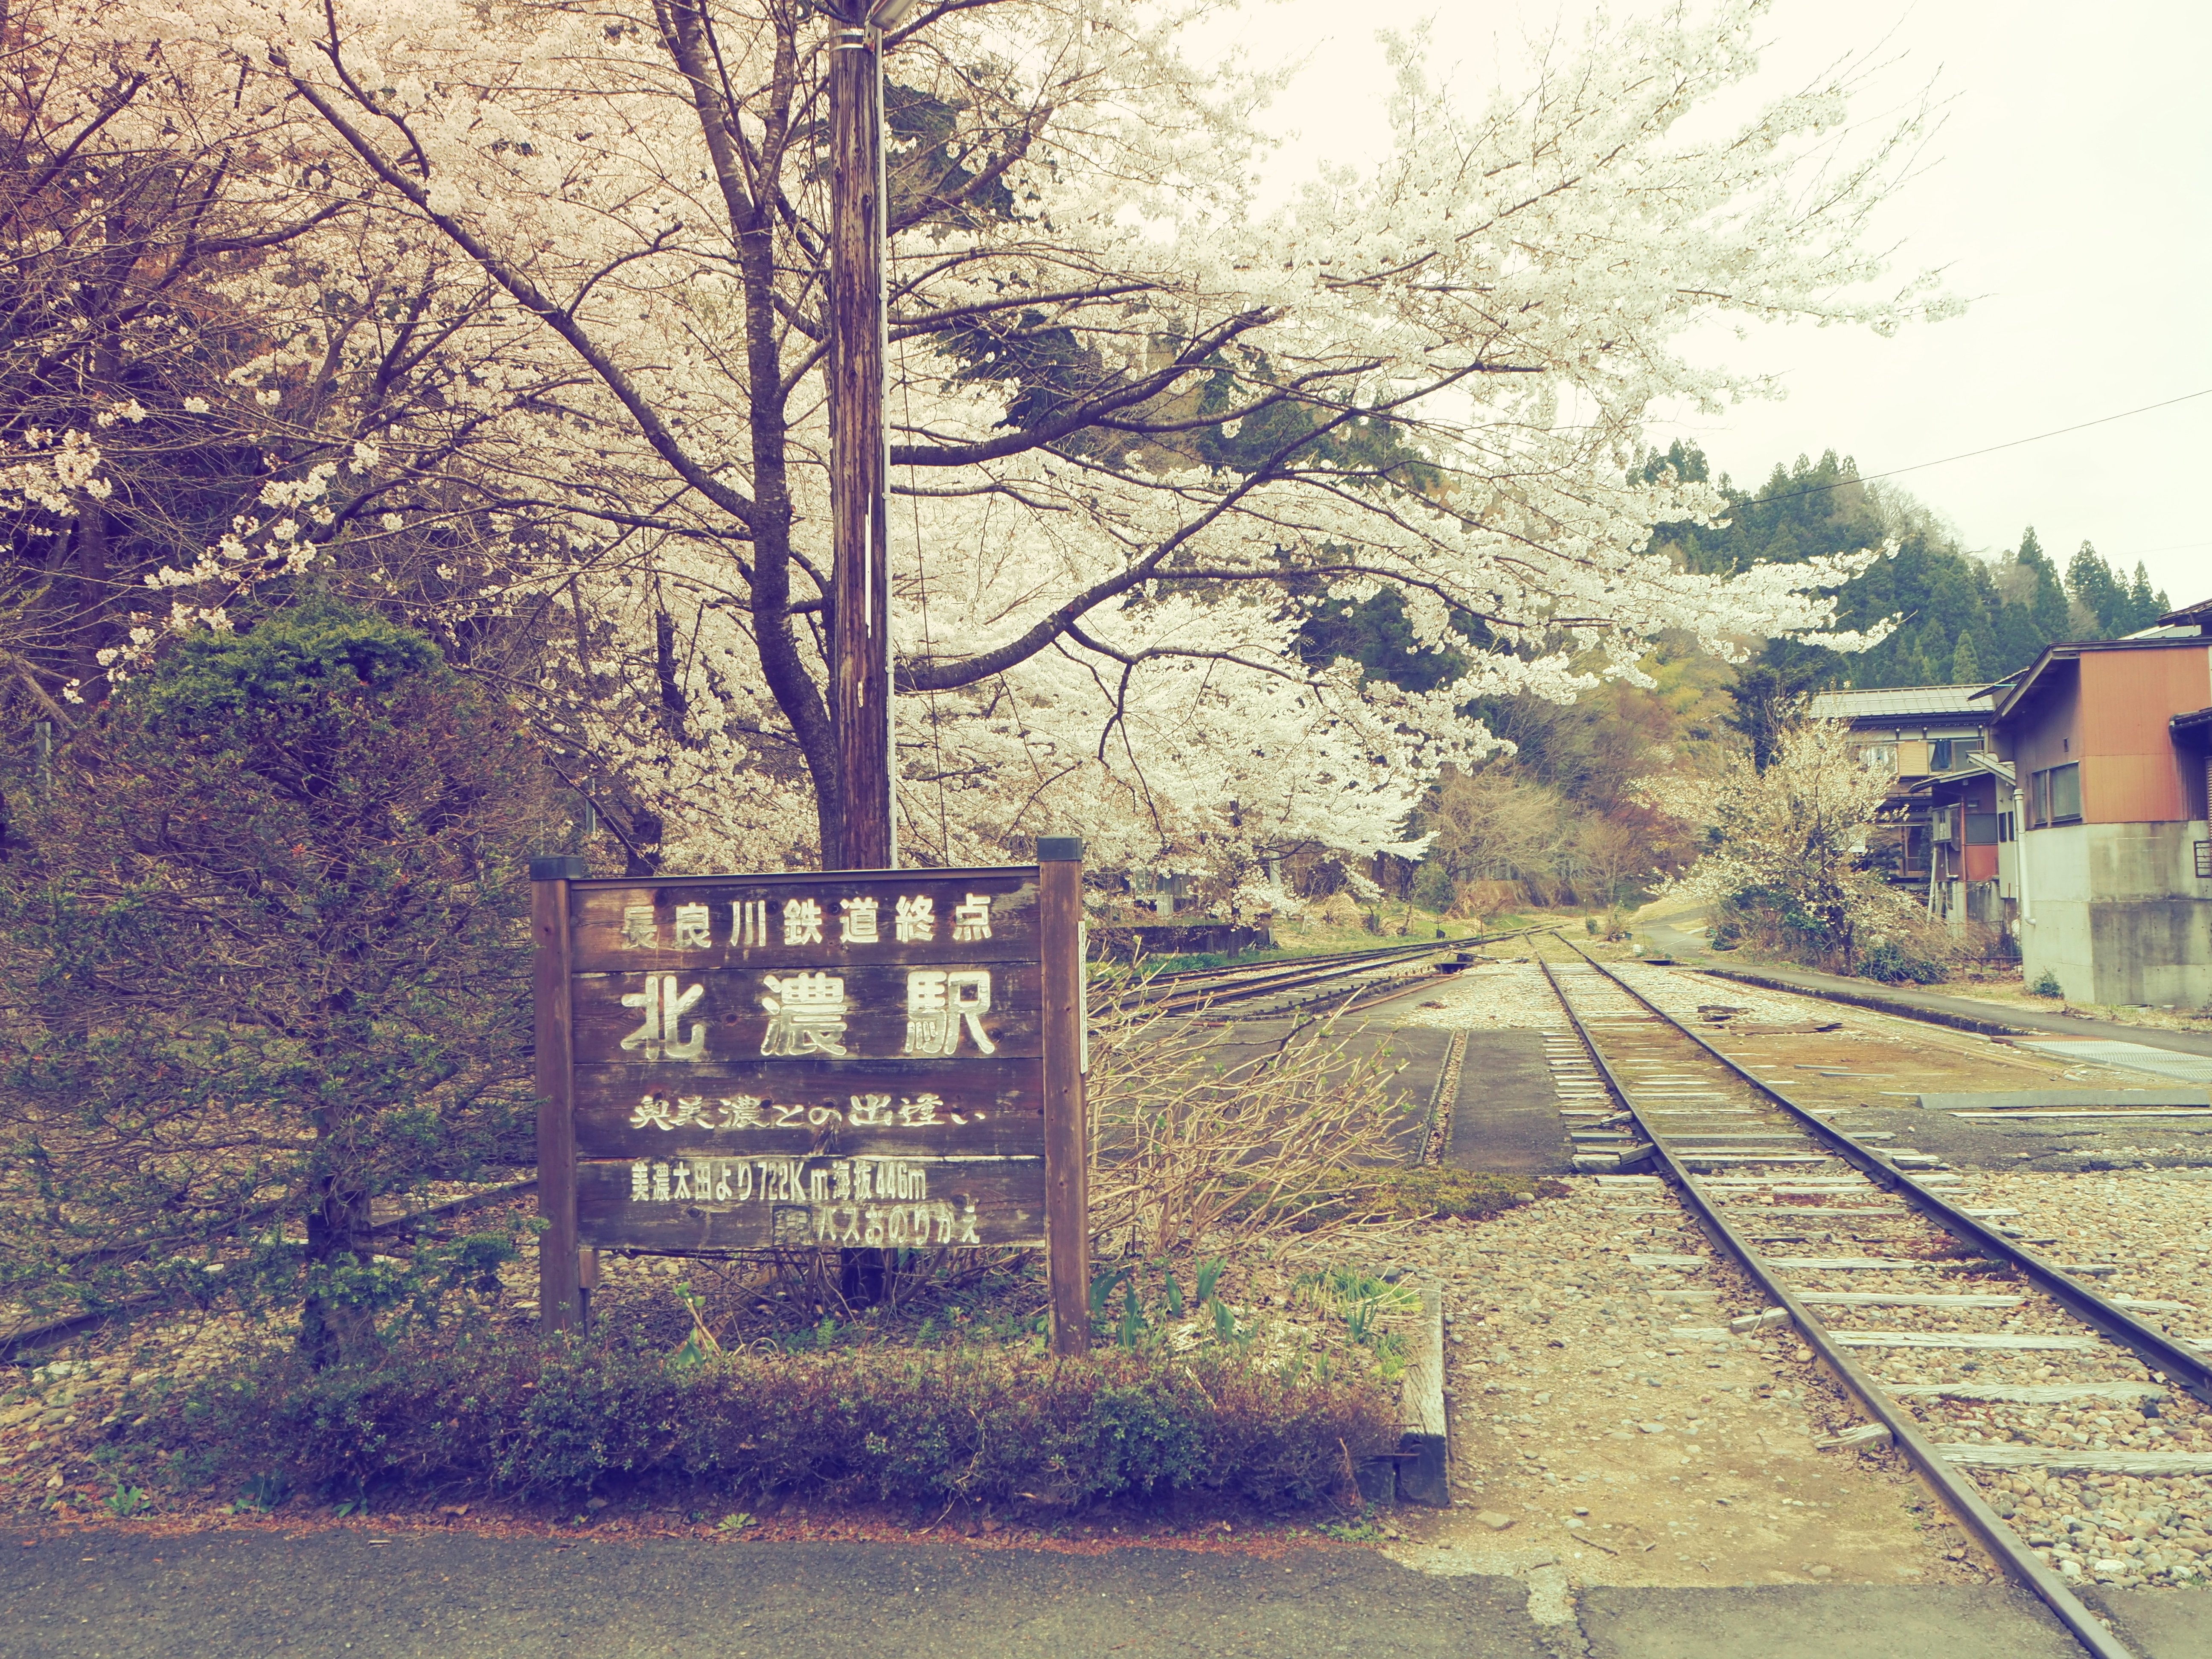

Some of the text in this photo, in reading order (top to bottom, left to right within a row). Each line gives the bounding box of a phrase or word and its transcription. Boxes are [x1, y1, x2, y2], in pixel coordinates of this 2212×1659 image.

[621, 893, 992, 950] 長良川鉄道終点
[620, 971, 996, 1060] 北濃駅
